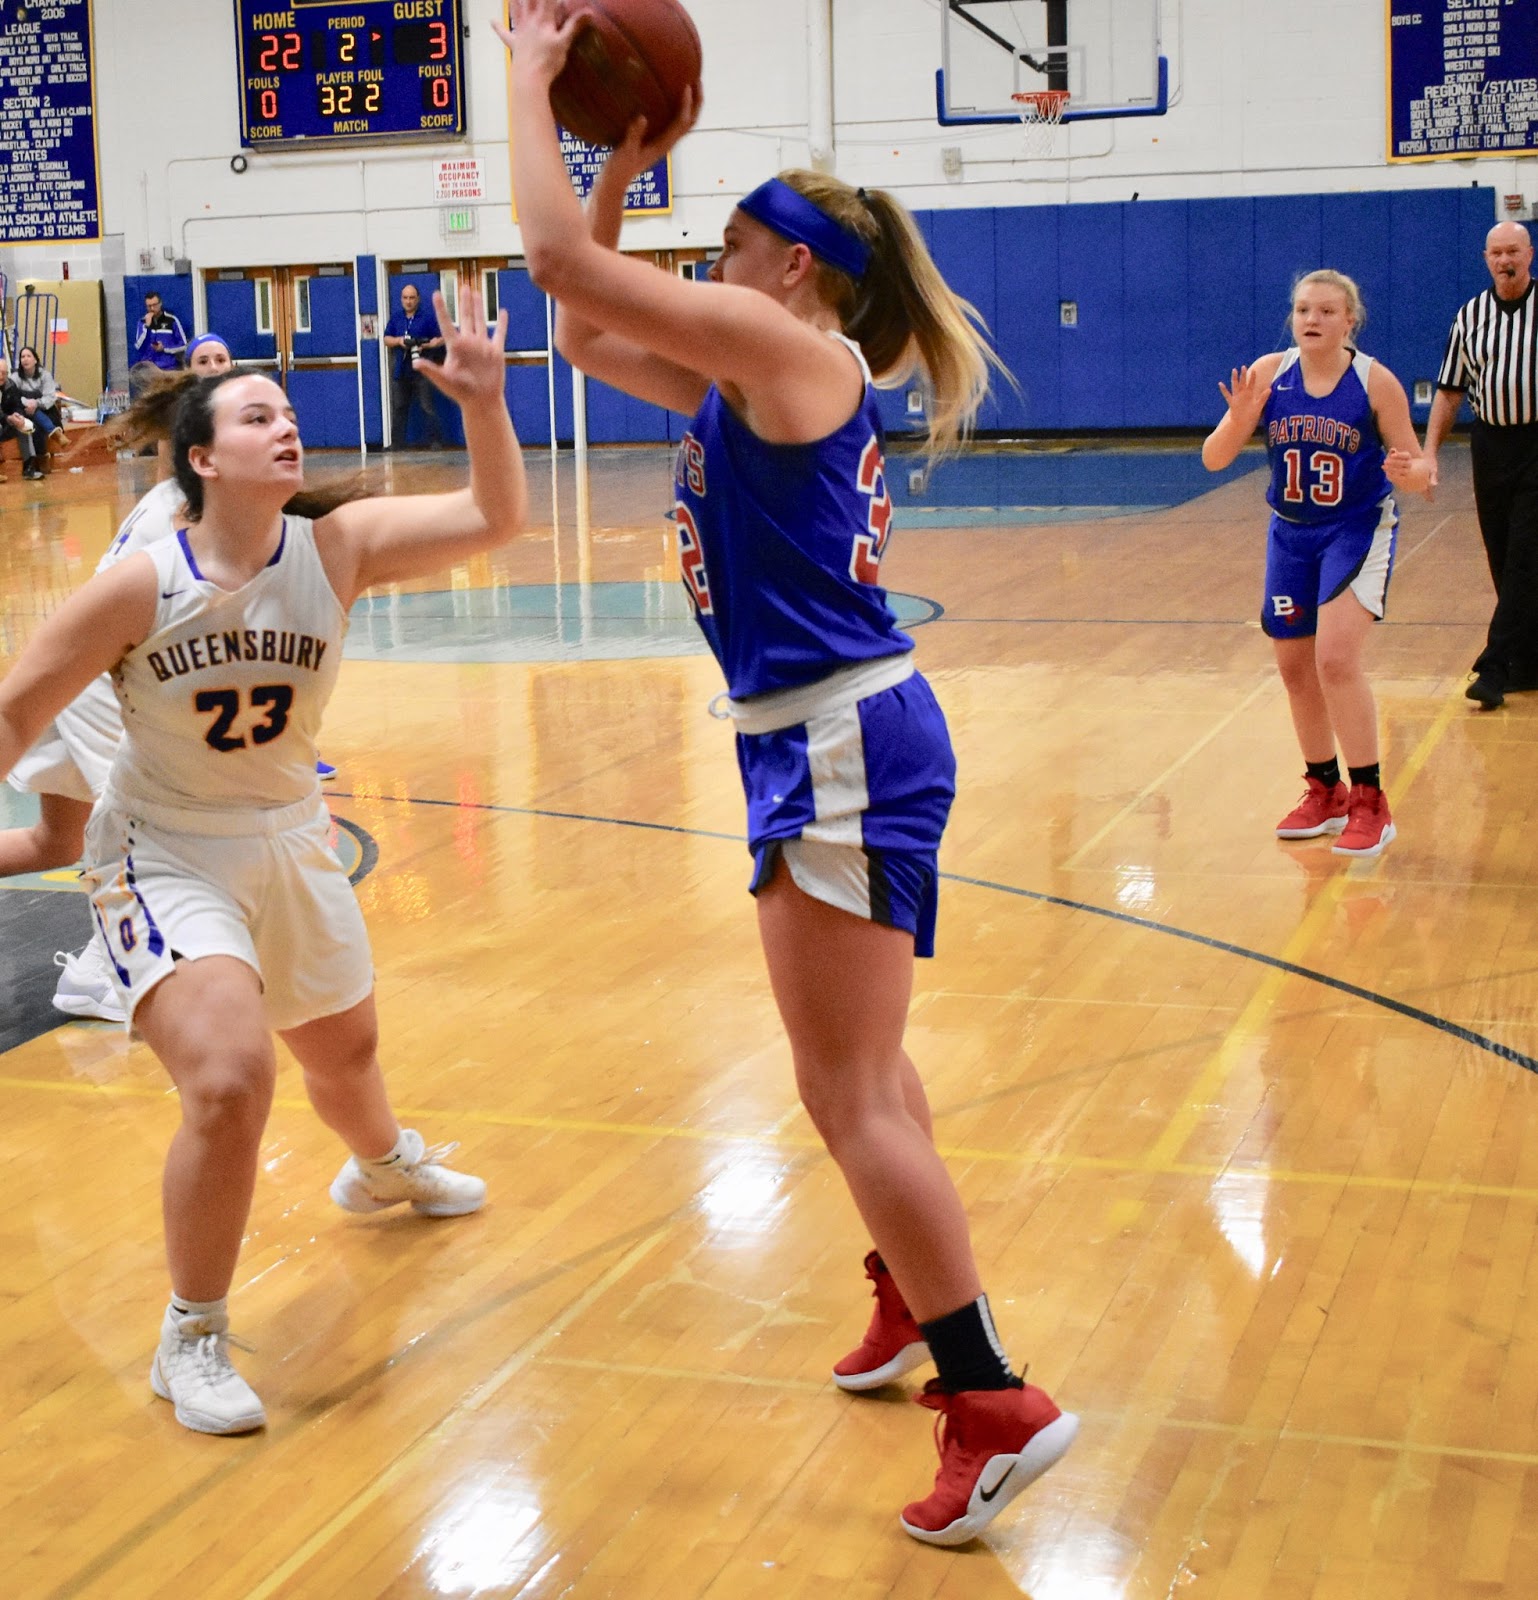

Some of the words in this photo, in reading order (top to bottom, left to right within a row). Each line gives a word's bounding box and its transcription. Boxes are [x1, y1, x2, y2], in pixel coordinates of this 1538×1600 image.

[41, 8, 65, 20] 2006
[394, 1, 444, 20] GUEST
[1443, 11, 1462, 22] BOYS
[1485, 9, 1498, 19] SKI
[253, 11, 296, 30] HOME
[328, 16, 365, 29] PERIOD
[1488, 21, 1500, 31] SKI
[5, 22, 41, 35] LEAGUE
[60, 32, 78, 41] TRACK
[428, 22, 447, 59] 3
[1485, 34, 1498, 44] SKI
[260, 33, 301, 71] 22
[340, 34, 355, 61] 2
[1488, 46, 1500, 56] SKI
[418, 64, 452, 78] FOULS
[1444, 60, 1485, 72] WRESTLING
[248, 76, 280, 90] FOULS
[316, 72, 354, 85] PLAYER
[358, 69, 384, 82] FOUL
[1457, 72, 1485, 83] HOCKEY
[18, 86, 33, 96] GOLF
[432, 78, 449, 108] 0
[3, 96, 40, 110] SECTION
[43, 95, 51, 107] 2
[261, 90, 277, 119] 0
[321, 85, 353, 115] 32
[365, 83, 380, 112] 2
[1474, 94, 1479, 104] A
[1482, 93, 1506, 104] STATE
[250, 125, 283, 139] SCORE
[333, 120, 369, 133] MATCH
[1486, 123, 1507, 133] FINAL
[1509, 121, 1529, 131] FOUR
[12, 149, 47, 162] STATES
[587, 153, 593, 163] A
[441, 161, 476, 171] MAXIMUM
[438, 171, 480, 182] OCCUPANCY
[452, 188, 482, 198] PERSONS
[644, 194, 661, 206] TEAMS
[15, 212, 56, 226] SCHOLAR
[59, 210, 97, 222] ATHLETE
[450, 212, 469, 229] EXIT
[8, 225, 37, 239] AWARD
[43, 225, 54, 237] 19
[57, 224, 86, 237] TEAMS
[1269, 414, 1361, 454] PATRIOTS
[1284, 448, 1344, 506] 13
[147, 629, 327, 682] QUEENSBURY
[193, 684, 296, 753] 23
